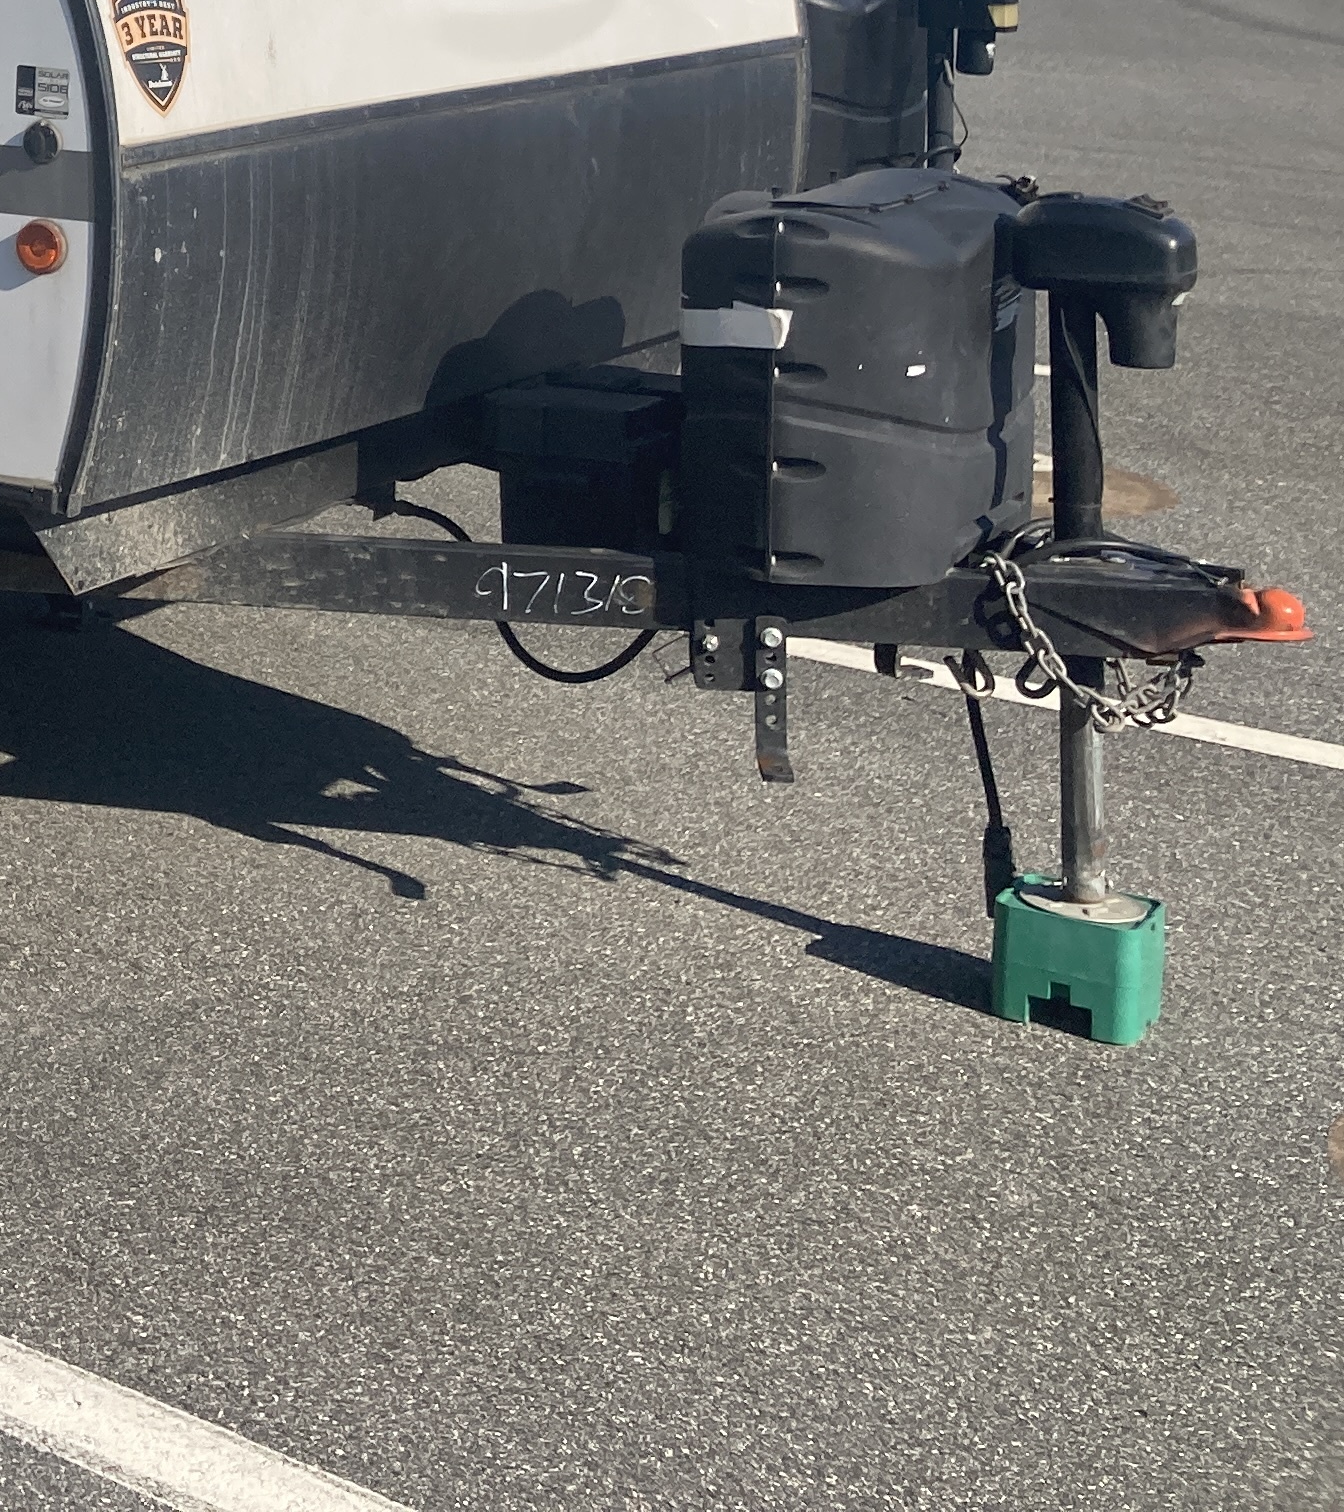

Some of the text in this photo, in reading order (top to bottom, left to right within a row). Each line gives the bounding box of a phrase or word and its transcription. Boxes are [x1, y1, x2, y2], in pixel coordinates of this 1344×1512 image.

[121, 13, 184, 46] 3 YEAR
[38, 70, 69, 79] SOLAR
